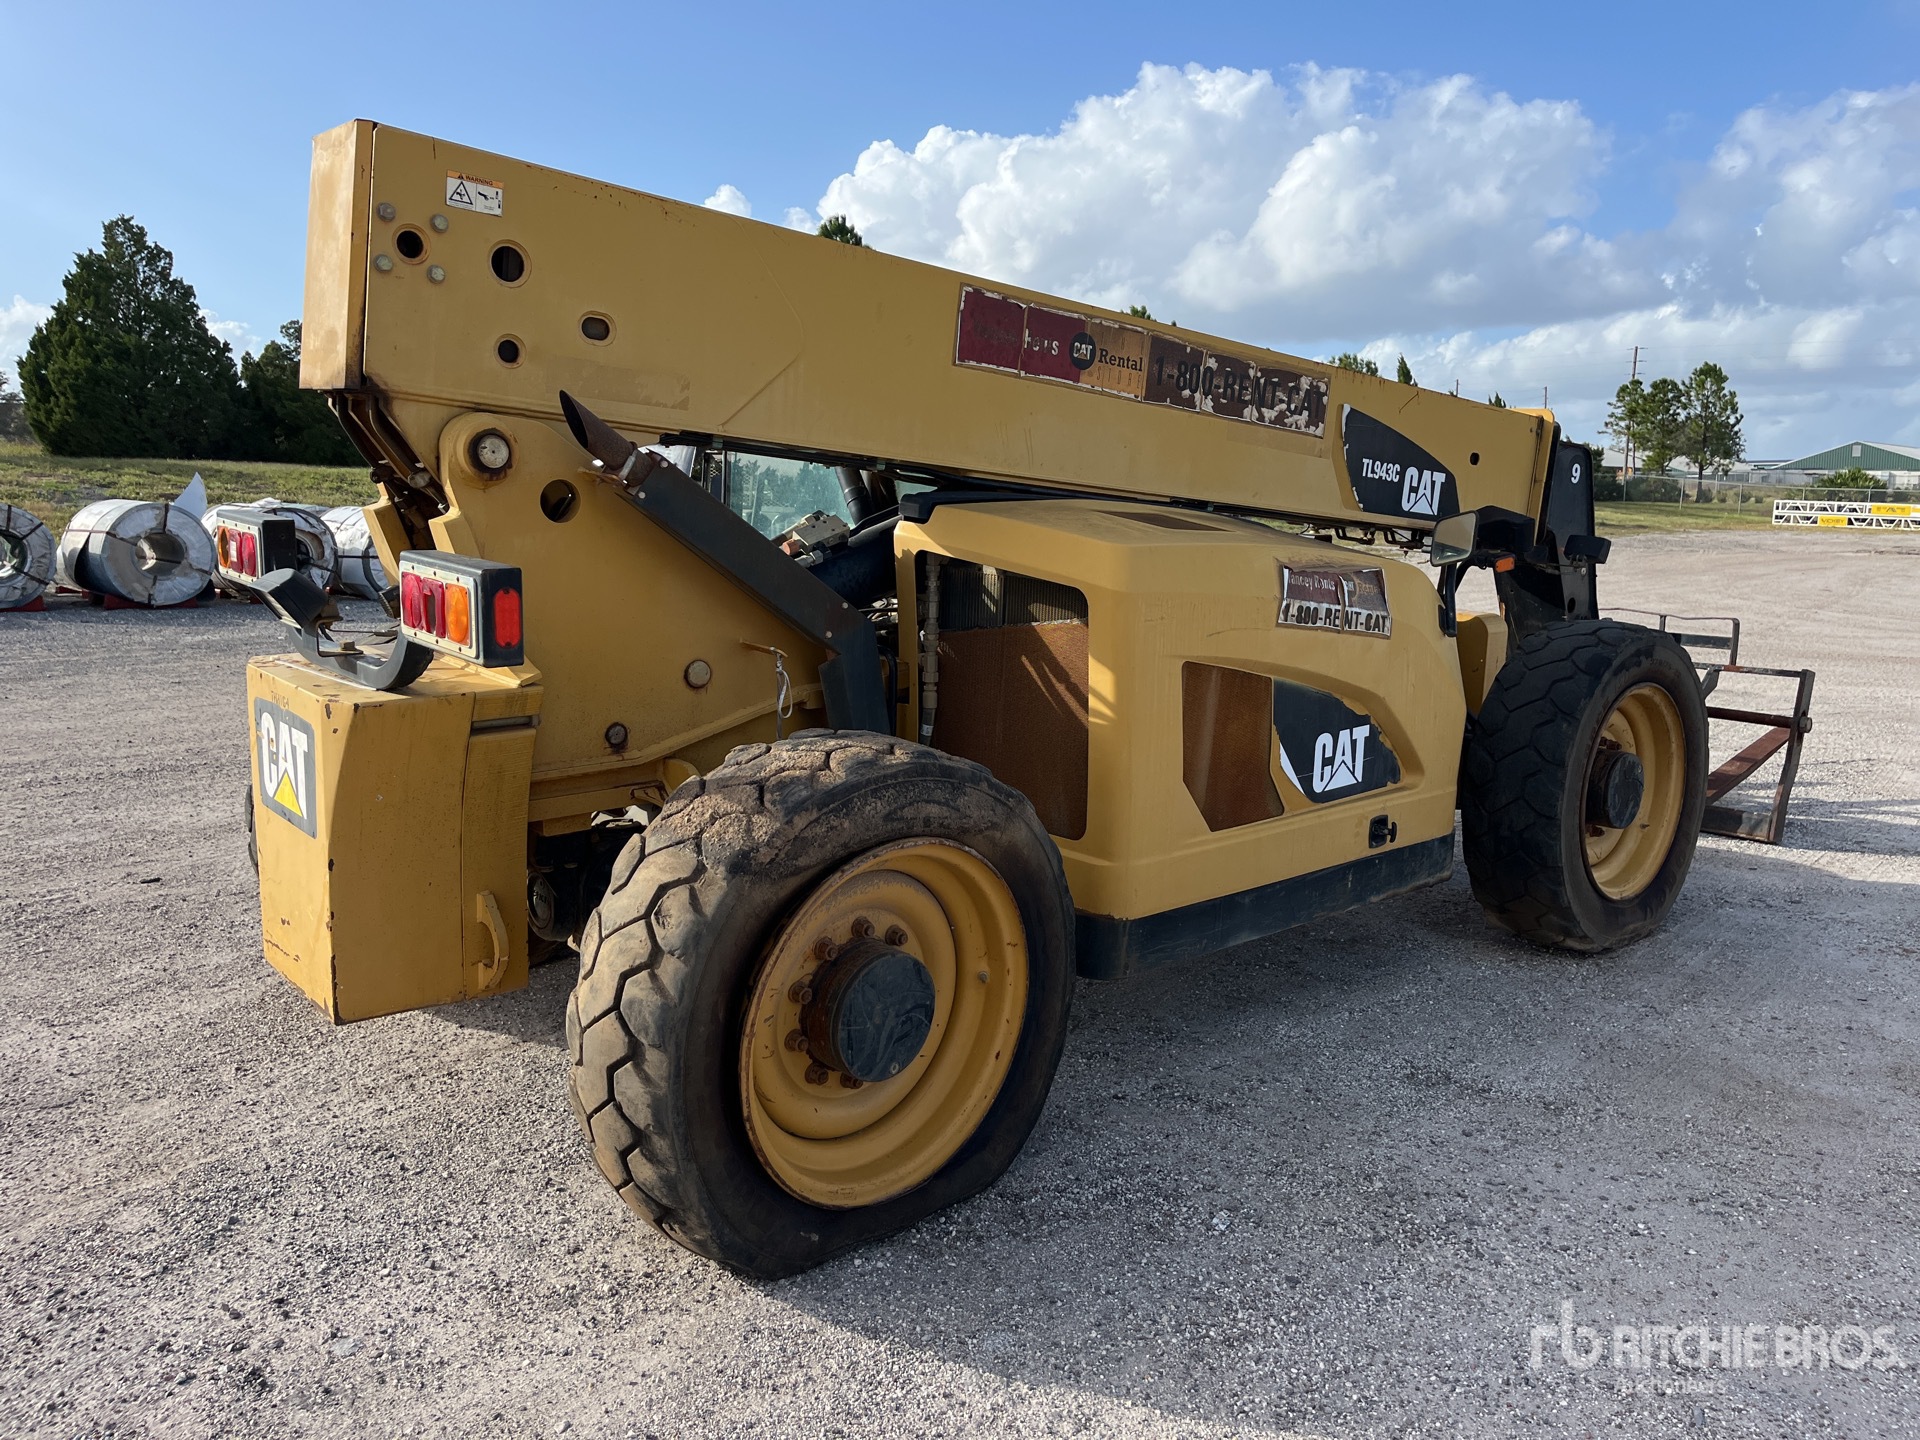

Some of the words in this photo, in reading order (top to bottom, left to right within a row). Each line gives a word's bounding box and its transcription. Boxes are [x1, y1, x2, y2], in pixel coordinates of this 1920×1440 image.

[466, 175, 493, 186] WARNING
[1073, 341, 1093, 361] CAT
[1097, 347, 1143, 372] Rental
[1362, 458, 1401, 483] TL943C
[1401, 466, 1446, 516] CAT
[1571, 463, 1581, 484] 9
[1281, 602, 1388, 633] 1-800-RENT-CAT
[261, 711, 308, 820] CAT
[1312, 724, 1370, 794] CAT
